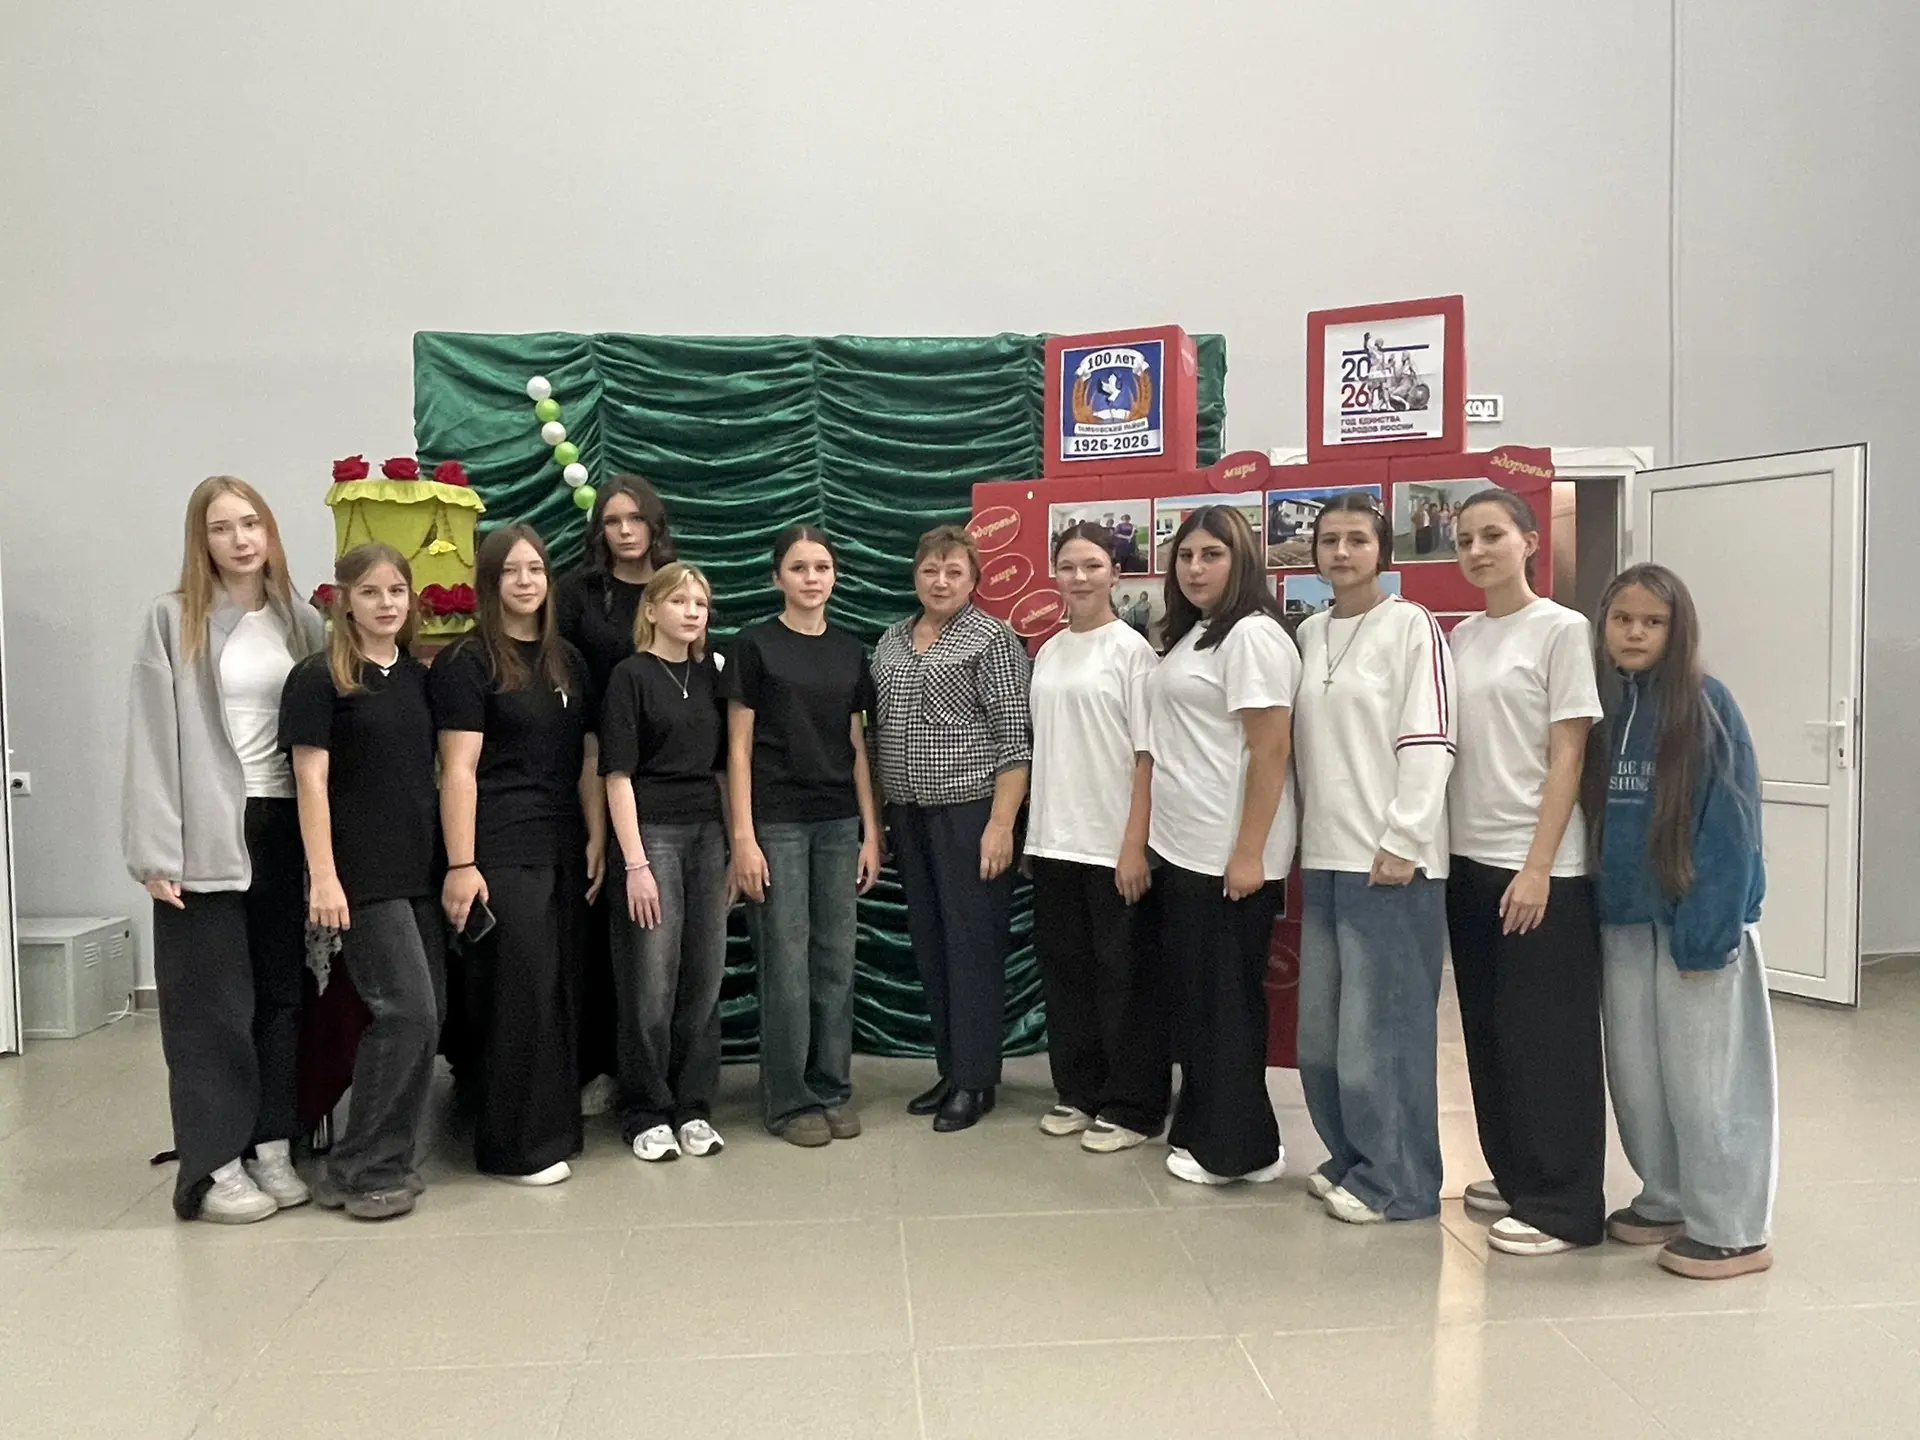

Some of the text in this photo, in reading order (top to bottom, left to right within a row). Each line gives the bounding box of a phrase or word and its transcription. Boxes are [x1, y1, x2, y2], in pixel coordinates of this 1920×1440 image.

[1088, 352, 1111, 370] 100
[1341, 356, 1371, 383] 20
[1341, 383, 1369, 408] 26
[1341, 418, 1356, 426] ГОД
[1341, 423, 1414, 434] НАРОДОВ РОССИИ
[1074, 434, 1149, 452] 1926-2026
[1617, 760, 1637, 775] BE
